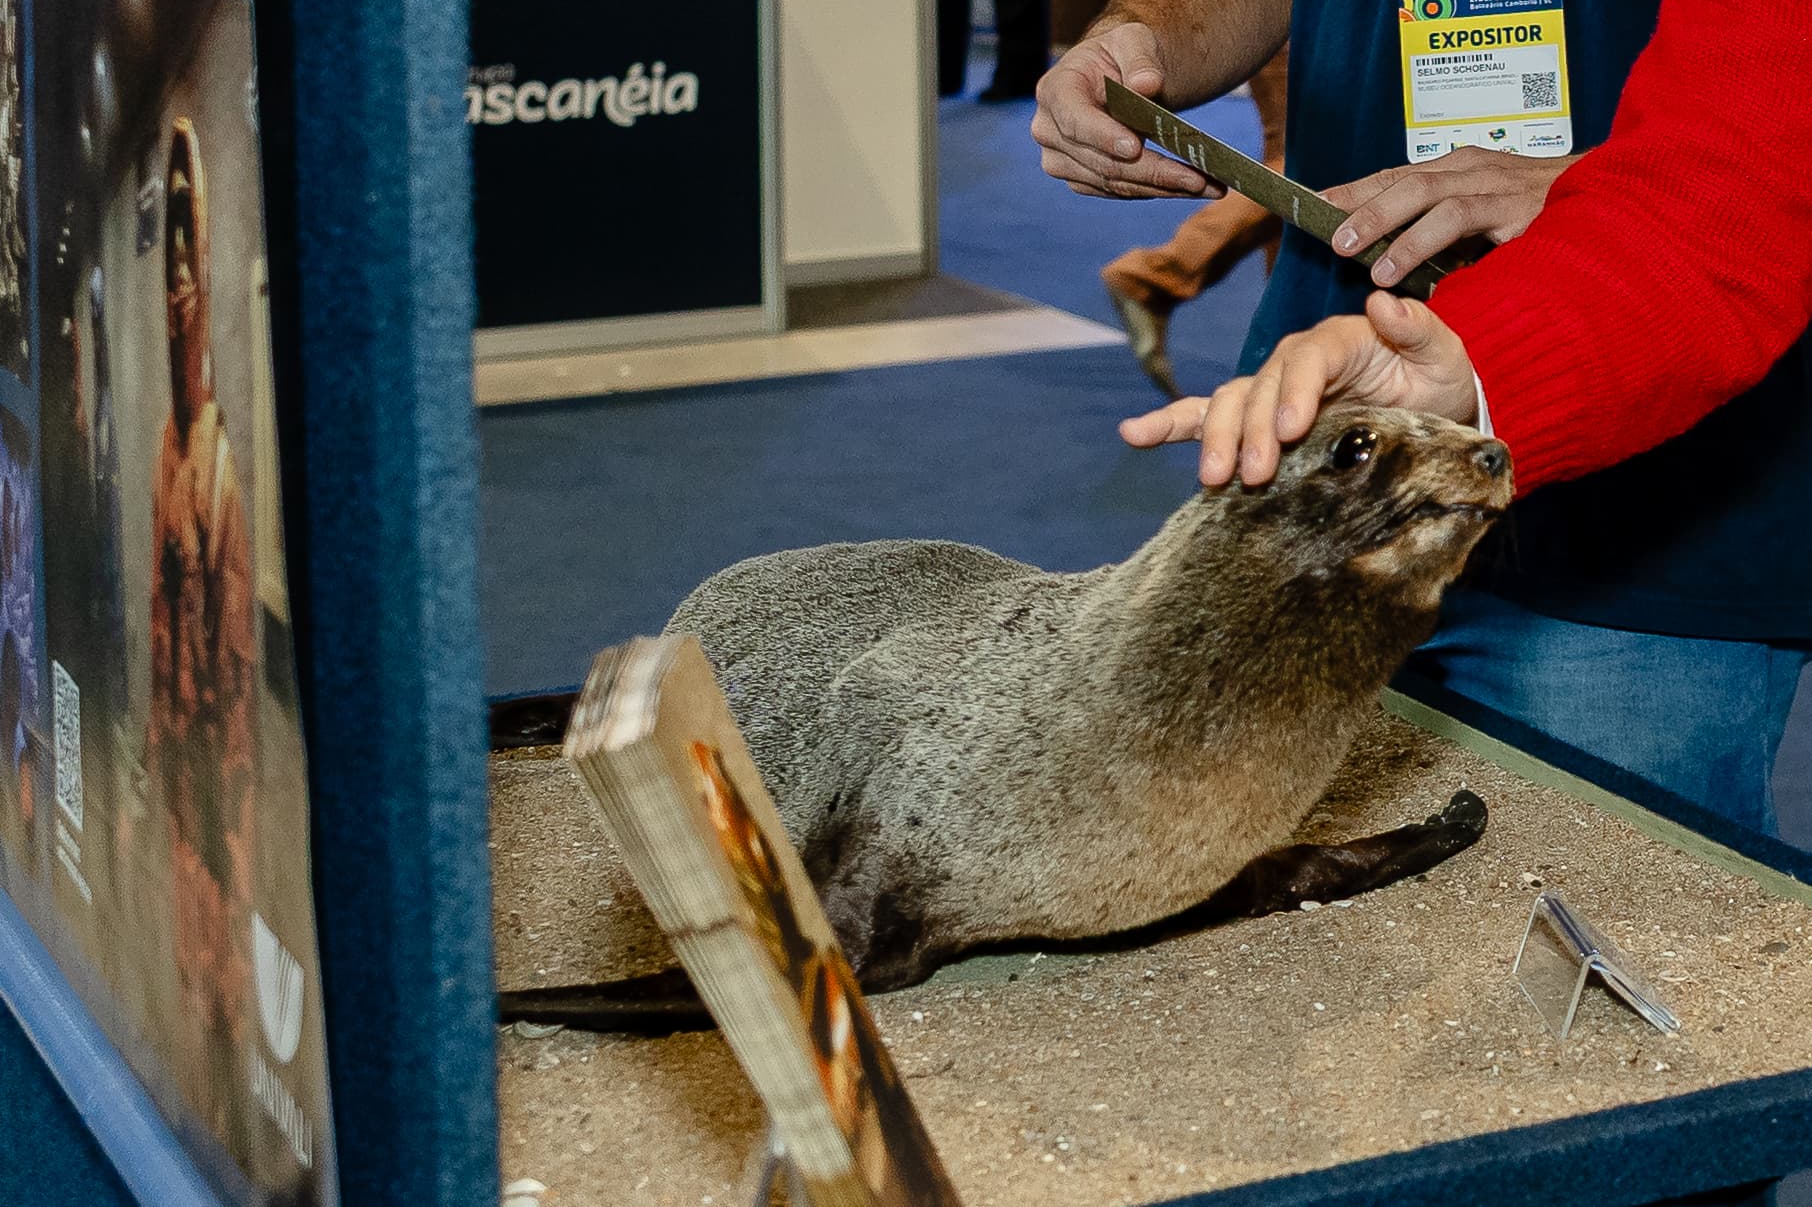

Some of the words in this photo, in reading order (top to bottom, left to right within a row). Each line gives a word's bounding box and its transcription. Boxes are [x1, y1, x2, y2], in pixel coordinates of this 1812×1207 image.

[1428, 24, 1543, 50] EXPOSITOR
[1417, 66, 1451, 77] SELMO
[1452, 62, 1506, 74] SCHOENAU
[1416, 143, 1440, 153] BNT
